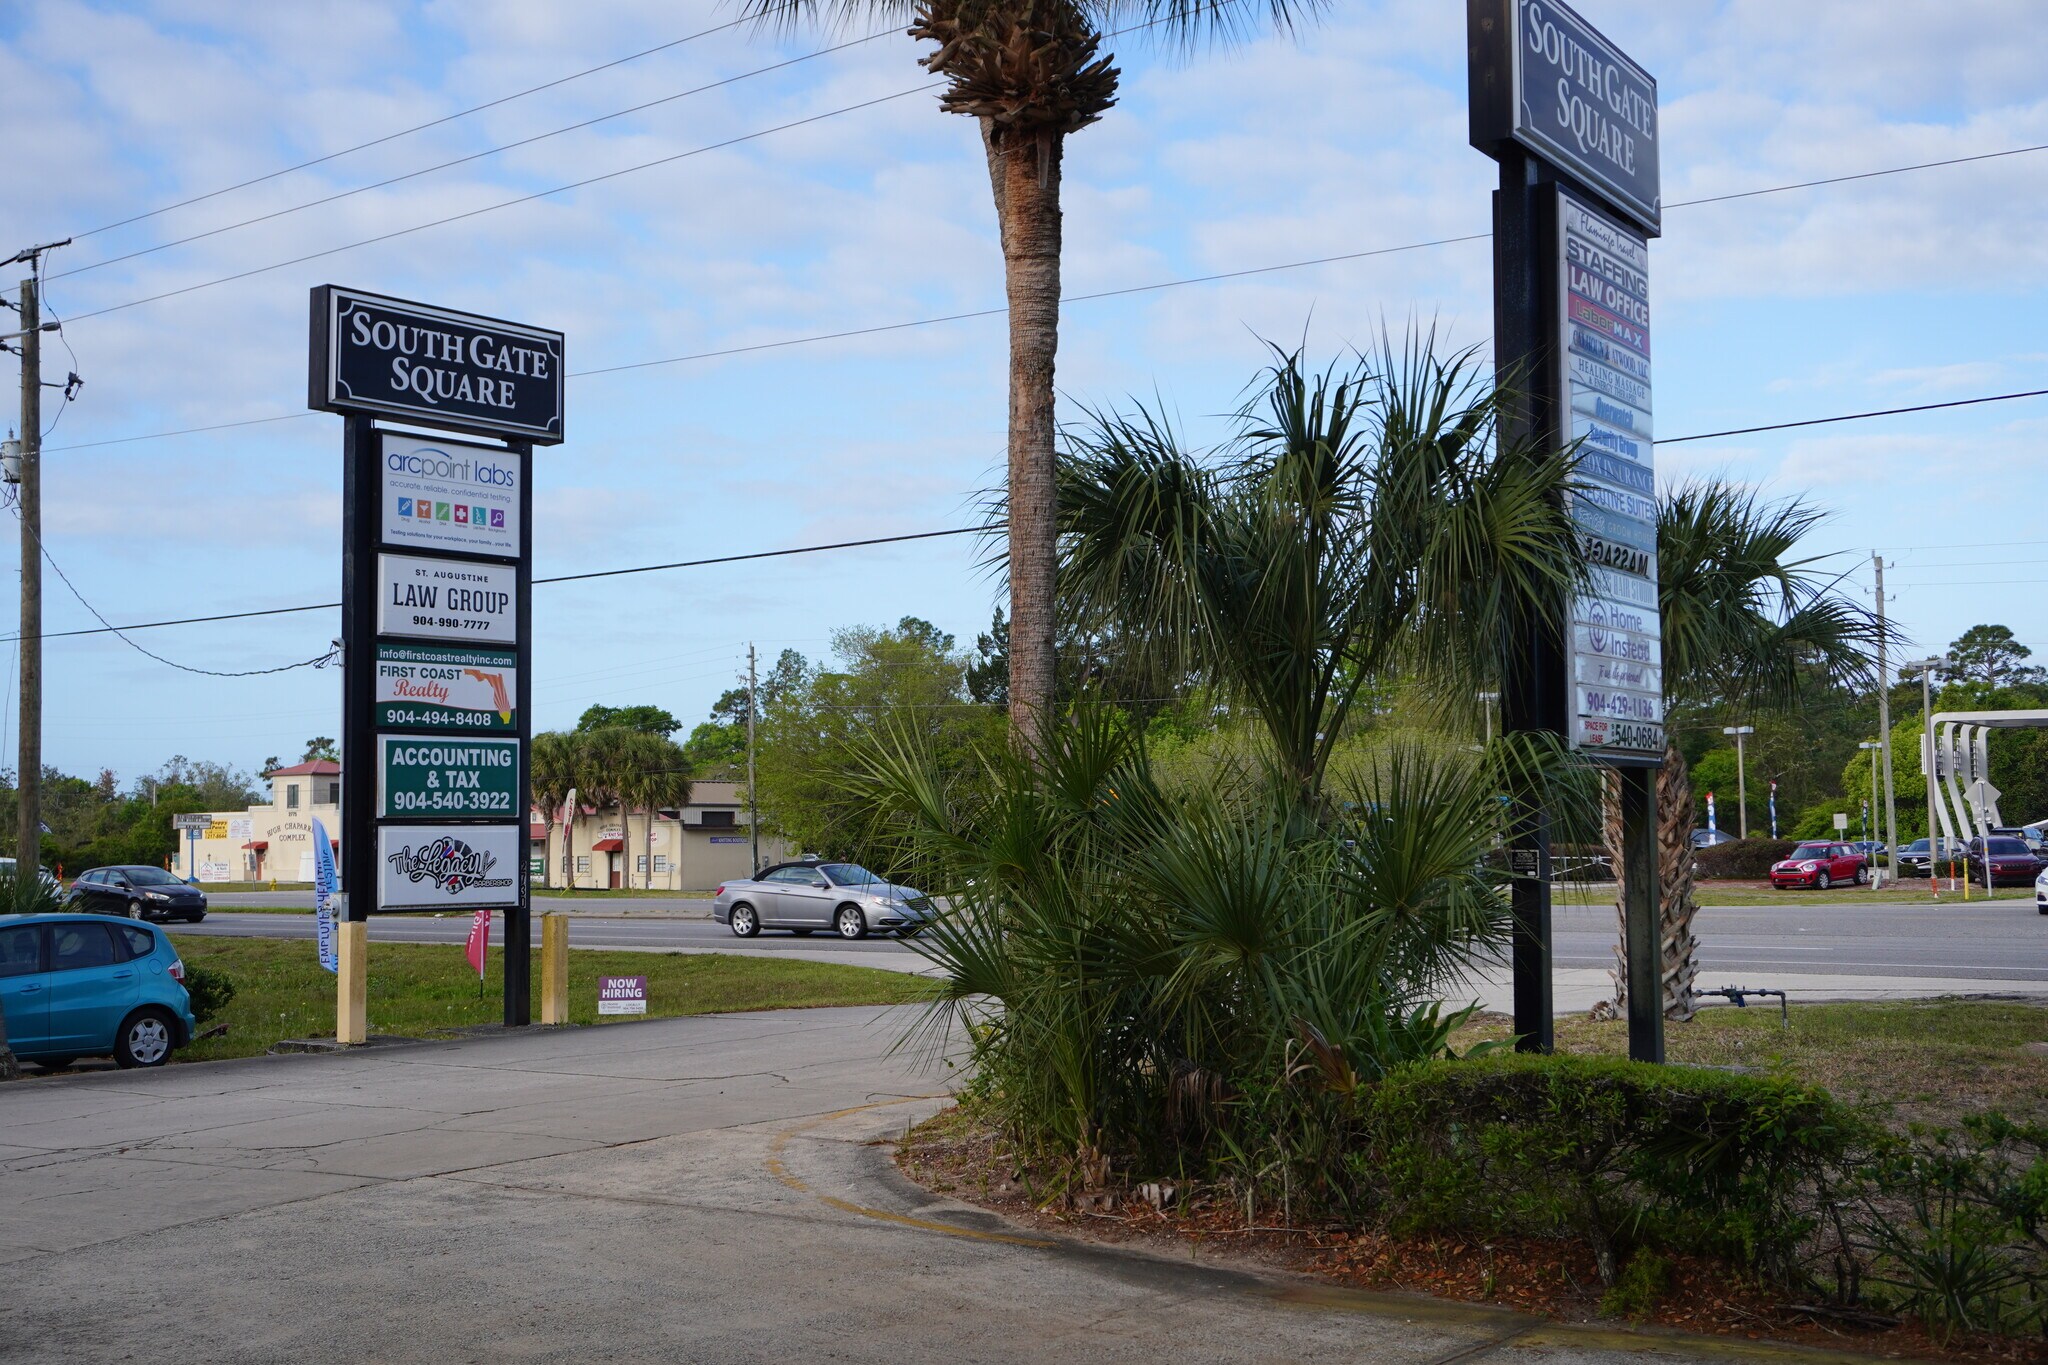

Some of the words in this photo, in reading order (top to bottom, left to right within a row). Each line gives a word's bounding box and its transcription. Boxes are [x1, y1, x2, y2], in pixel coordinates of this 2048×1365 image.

[1557, 77, 1635, 177] SQUARE
[1568, 237, 1648, 299] STAFFING
[1571, 265, 1603, 301] LAW
[1605, 285, 1648, 328] OFFICE
[390, 356, 516, 409] SQUARE
[1578, 358, 1613, 383] HEALING
[1614, 373, 1646, 400] MASSAGE
[388, 453, 470, 480] arcpoint
[474, 460, 514, 487] labs
[1603, 459, 1654, 493] INSURANCE
[451, 488, 489, 500] confidential
[1627, 495, 1656, 522] SUITES
[415, 568, 428, 577] ST.
[434, 571, 489, 583] AUGUSTINE
[393, 582, 438, 609] LAW
[447, 588, 509, 615] GROUP
[412, 615, 490, 630] 904-990-7777
[1610, 604, 1643, 633] Home
[379, 649, 512, 666] info@firstcoastrealtyinc.com
[1611, 633, 1650, 662] Instead
[380, 665, 416, 678] FIRST
[420, 667, 462, 680] COAST
[393, 678, 449, 704] Realty
[1587, 691, 1653, 719] 904-429-1136
[386, 709, 492, 726] 904-494-8408
[1584, 720, 1599, 731] SPACE
[1599, 722, 1608, 731] FOR
[1589, 734, 1604, 744] LEASE
[1615, 723, 1658, 749] 540-0684
[392, 747, 512, 767] ACCOUNTING
[426, 770, 440, 788] &
[445, 770, 481, 788] TAX
[394, 791, 510, 810] 904-540-3922
[266, 825, 281, 837] HIGH
[284, 822, 313, 833] CHAPARR
[279, 834, 306, 842] COMPLEX
[388, 845, 421, 874] The
[410, 839, 484, 889] Legacy
[602, 988, 642, 998] HIRING
[608, 978, 637, 989] NOW
